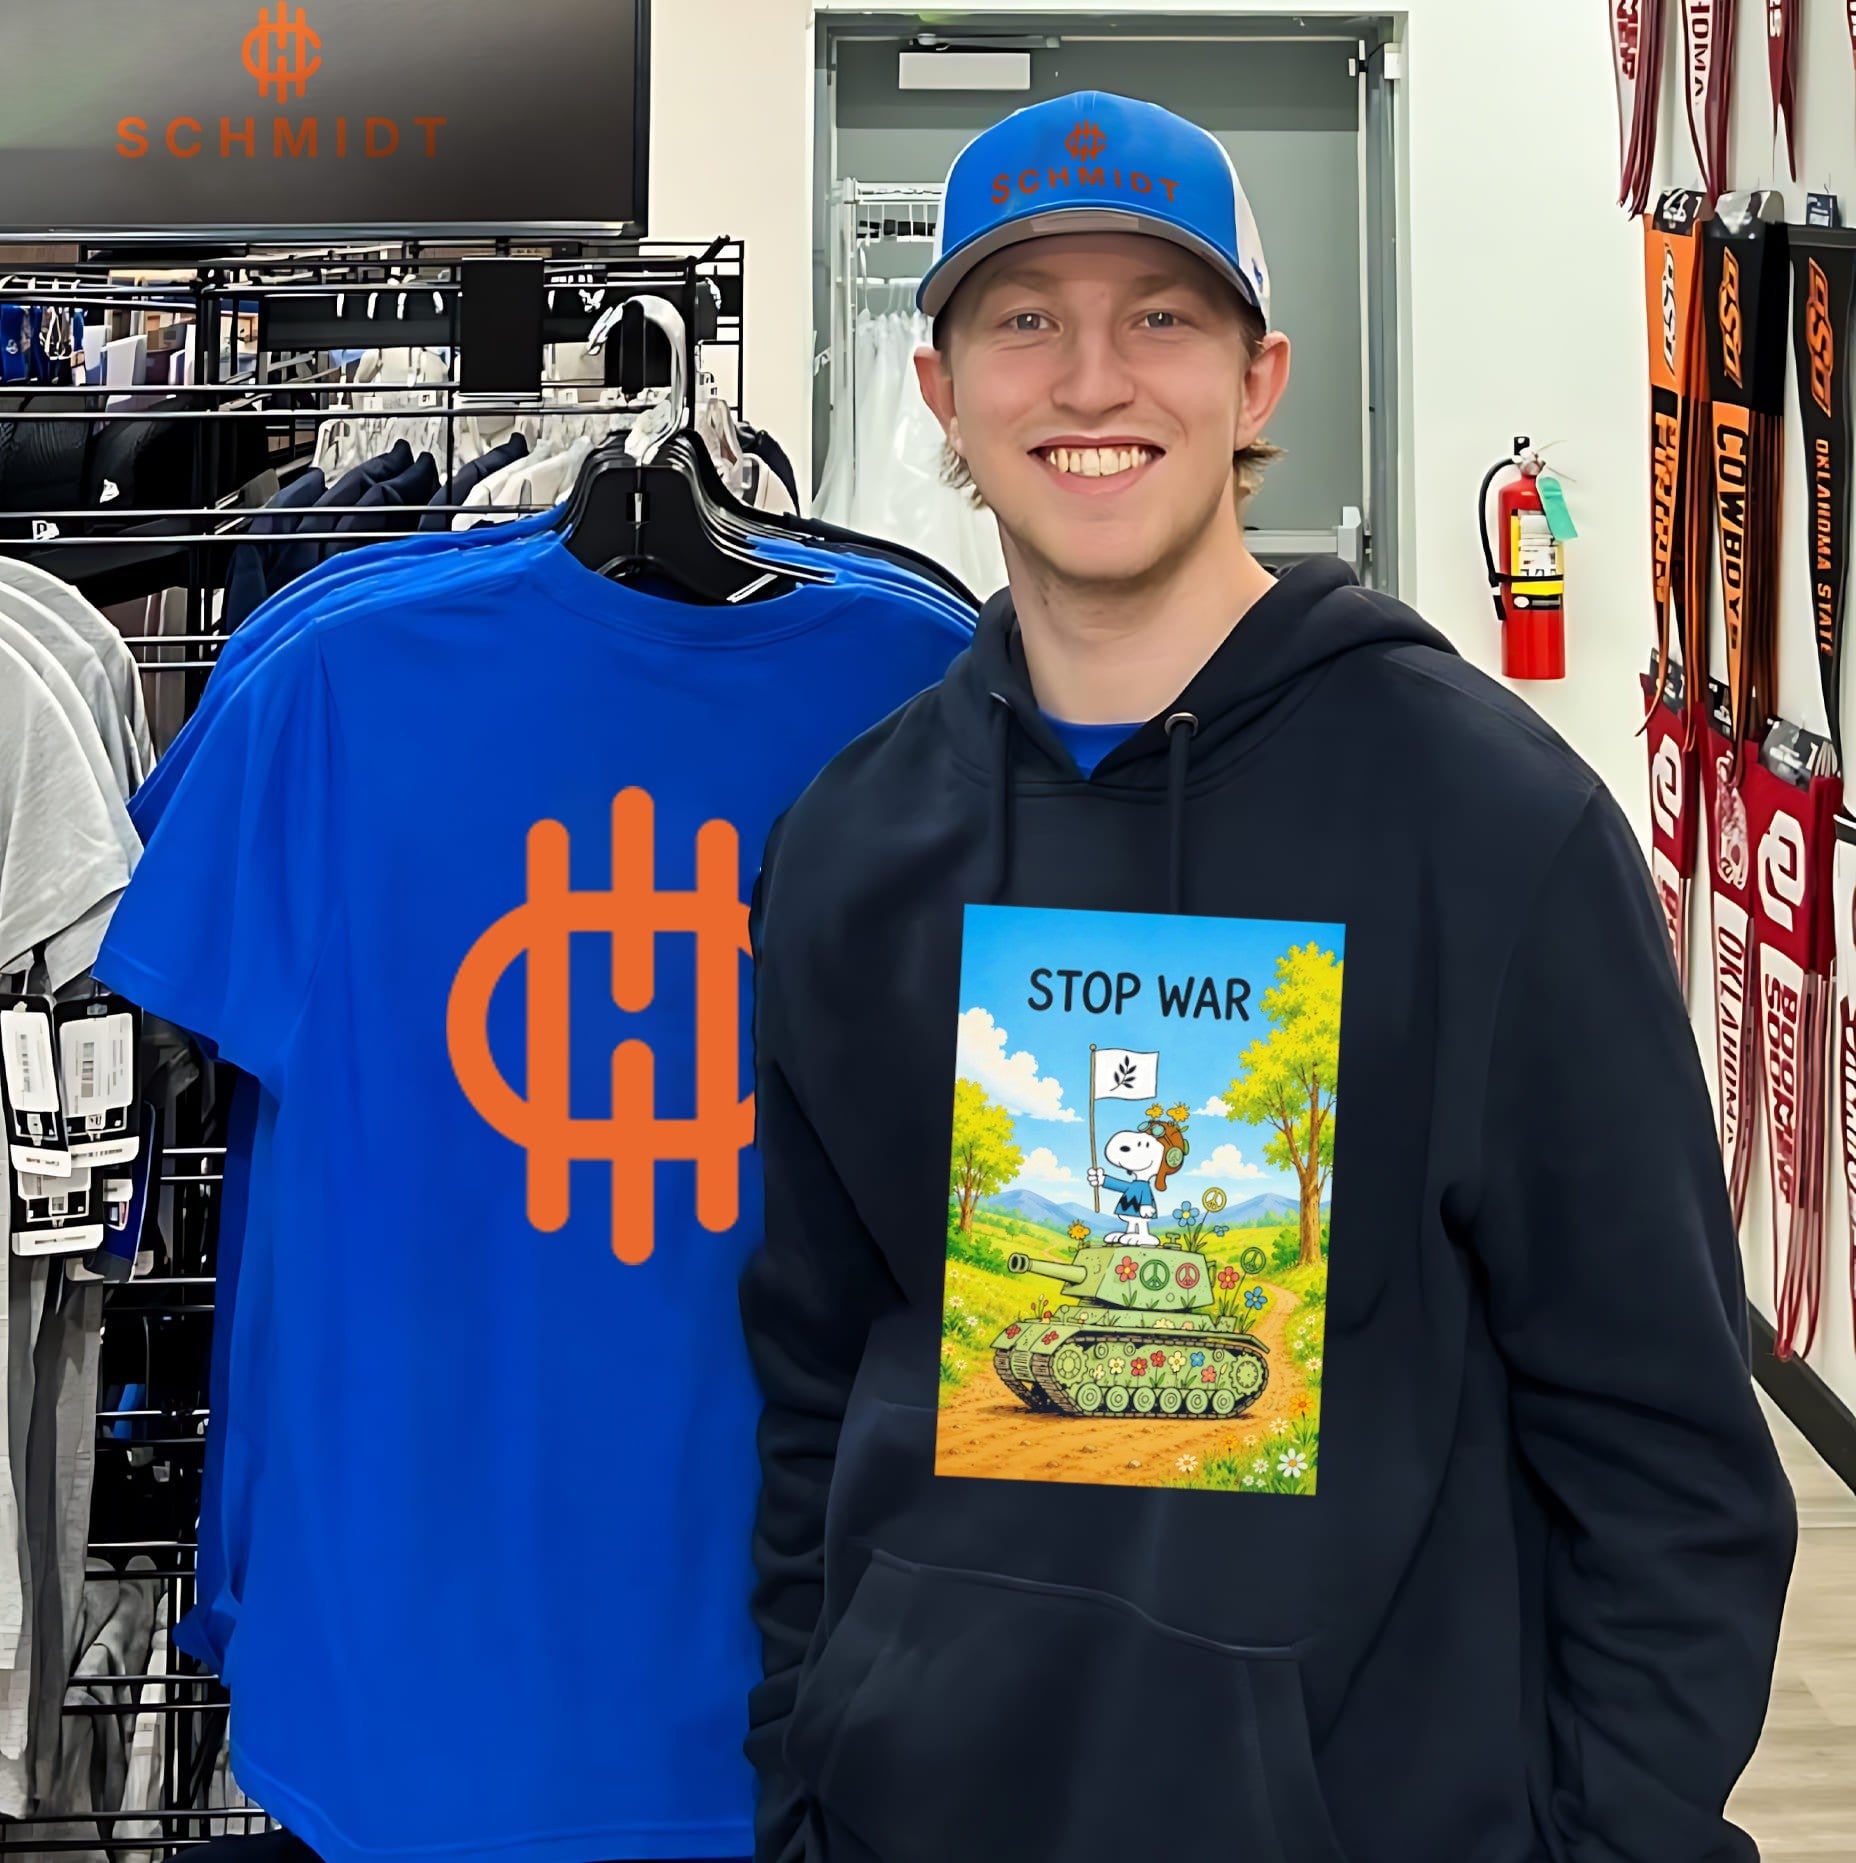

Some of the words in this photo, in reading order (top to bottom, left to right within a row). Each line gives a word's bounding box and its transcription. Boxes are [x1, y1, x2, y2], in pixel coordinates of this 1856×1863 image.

[116, 116, 448, 159] SCHMIDT
[991, 166, 1180, 205] SCHMIDT
[1026, 967, 1142, 1016] STOP
[1157, 974, 1252, 1022] WAR
